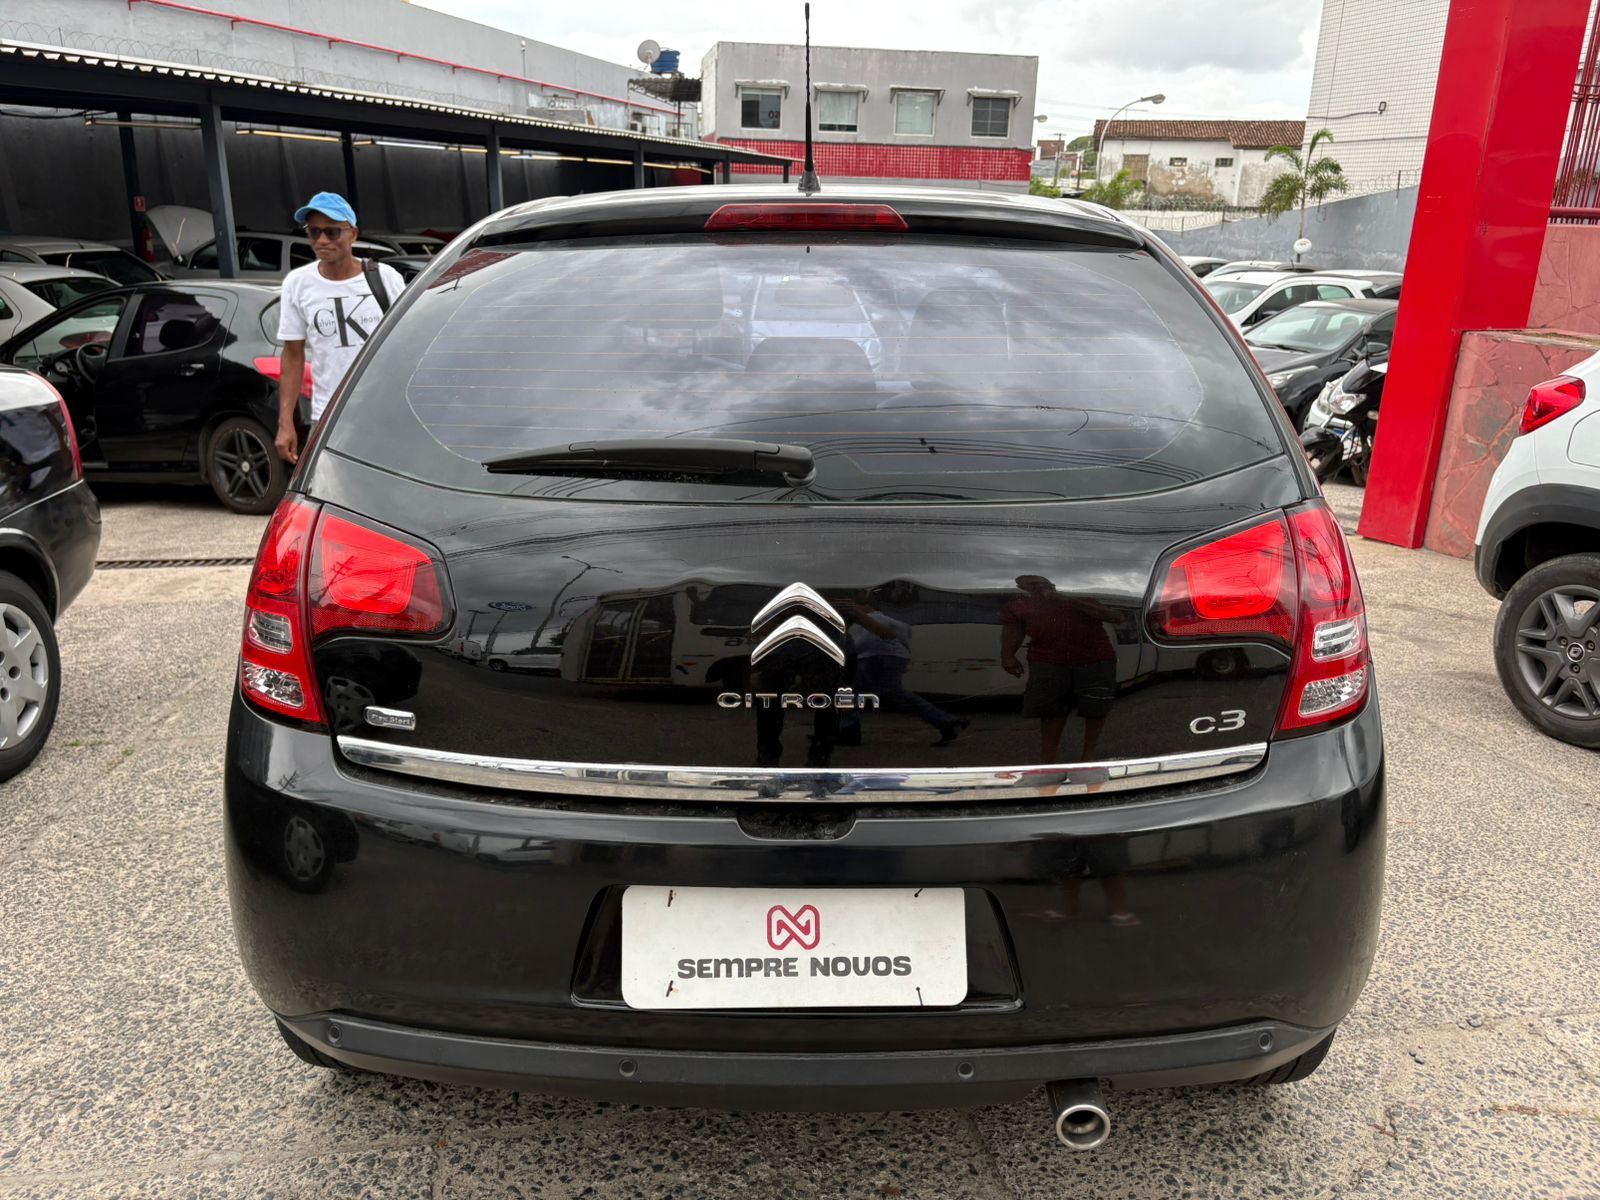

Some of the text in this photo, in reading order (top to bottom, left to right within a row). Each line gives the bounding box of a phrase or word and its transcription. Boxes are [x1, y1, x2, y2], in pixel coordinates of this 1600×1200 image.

[1189, 709, 1247, 734] C3
[677, 955, 912, 979] SEMPRE NOVOS
